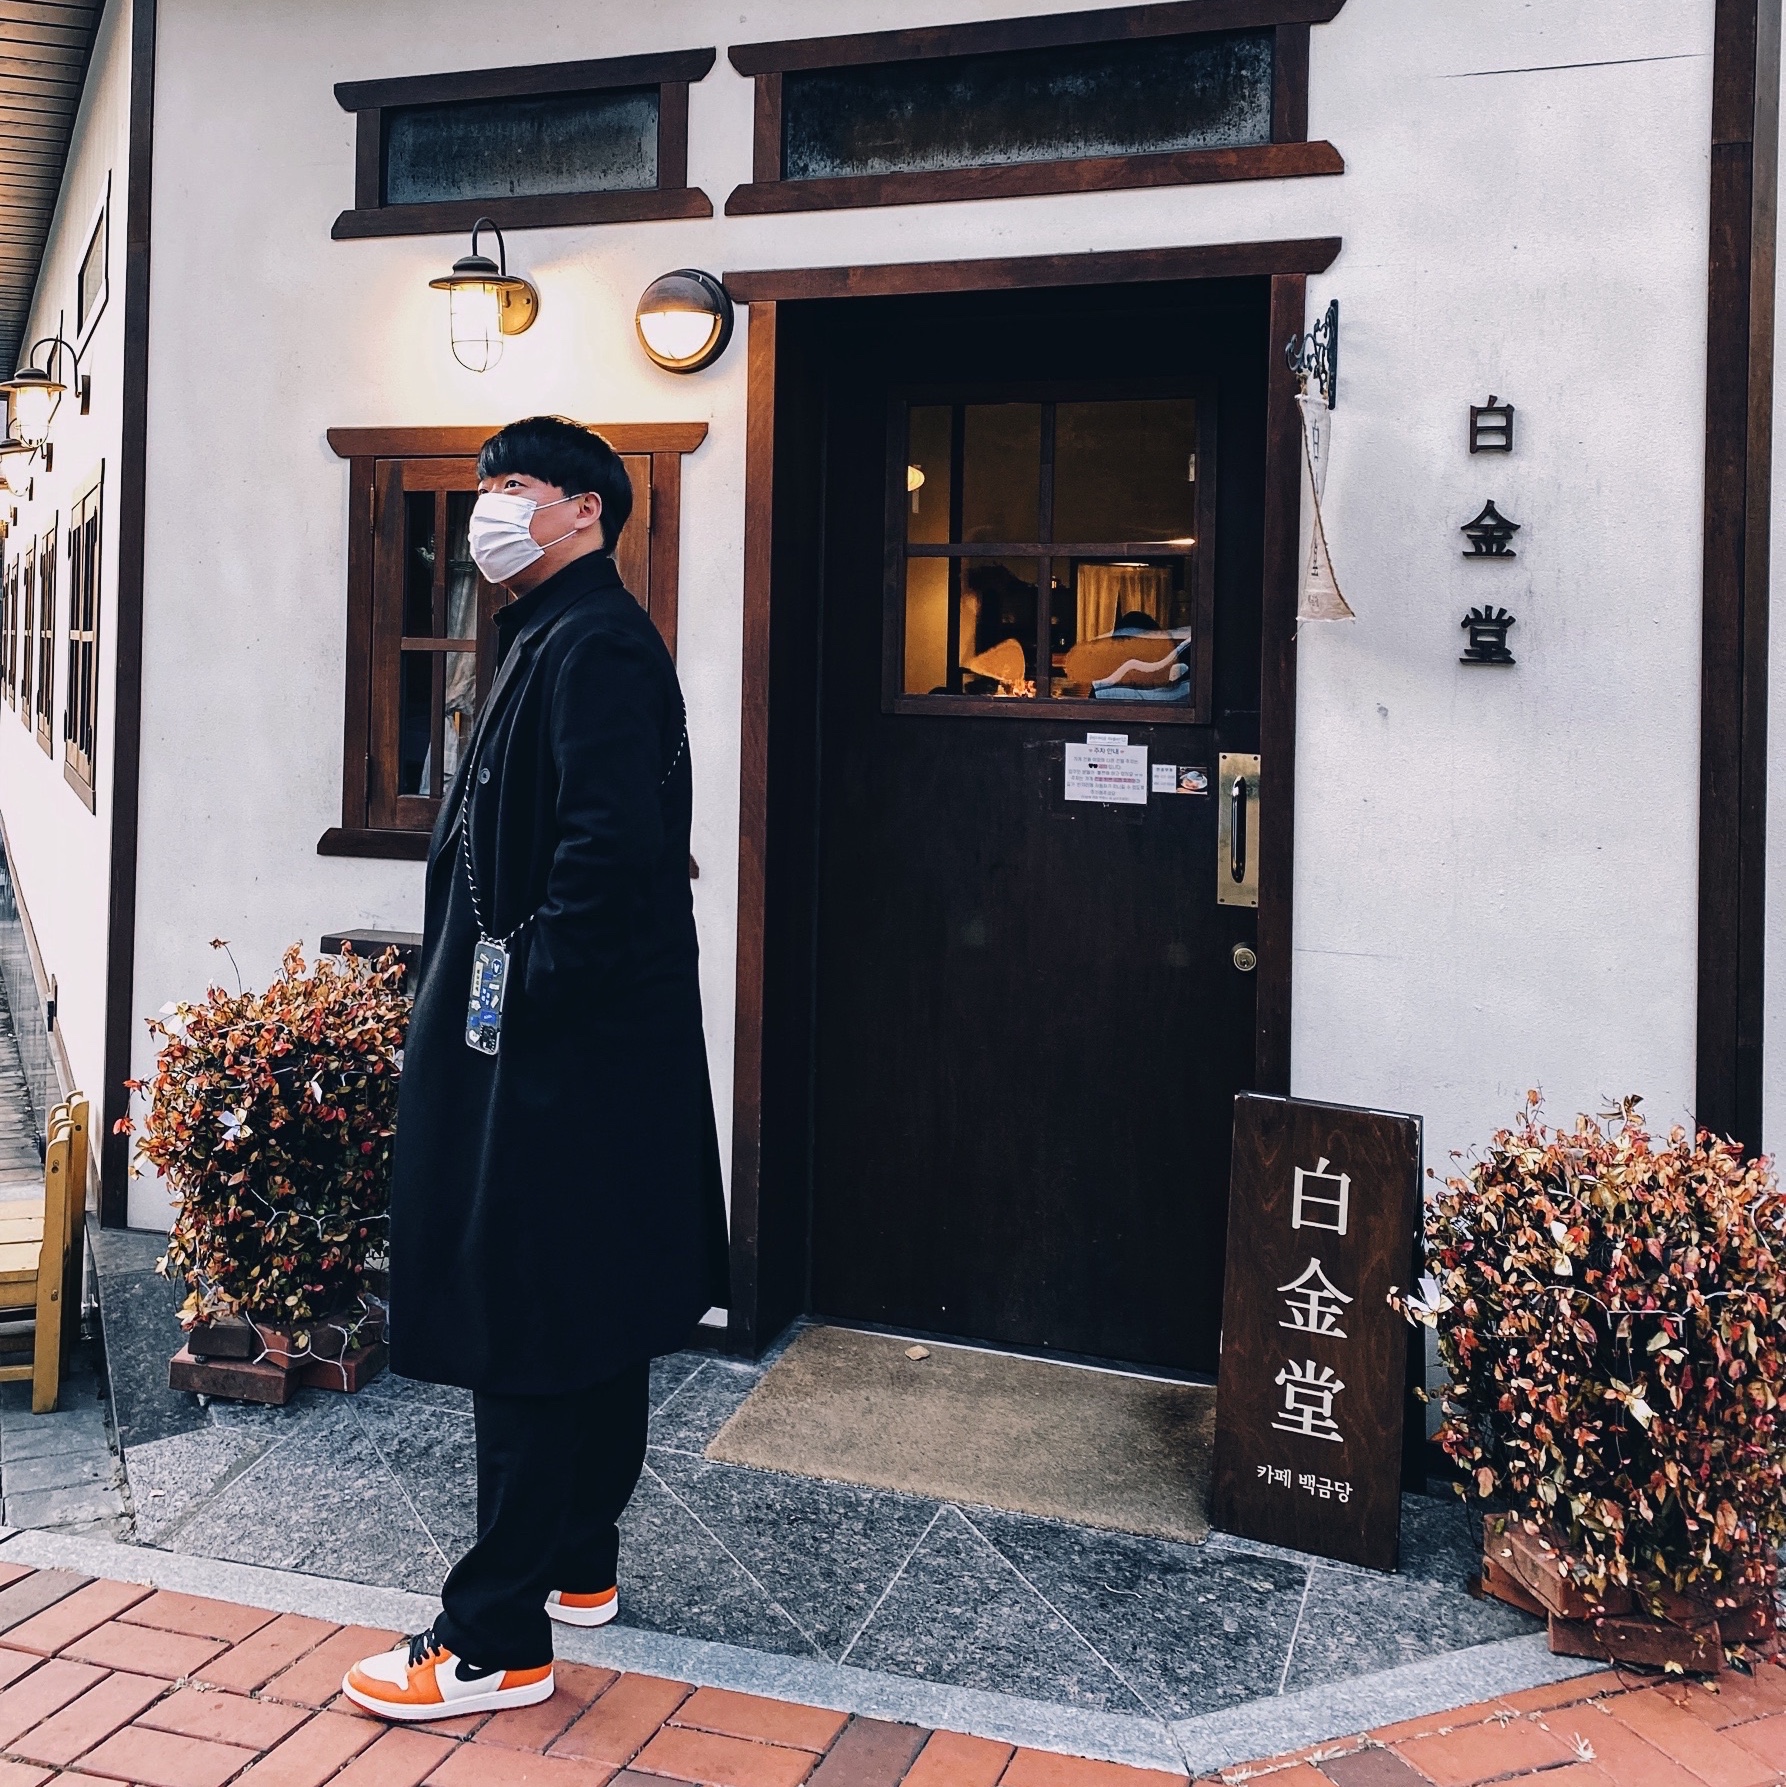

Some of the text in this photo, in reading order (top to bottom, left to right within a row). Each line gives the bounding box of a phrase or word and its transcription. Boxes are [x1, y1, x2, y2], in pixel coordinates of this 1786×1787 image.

[1459, 394, 1521, 665] 白金堂
[1271, 1156, 1354, 1443] 白金堂
[1257, 1464, 1353, 1503] 카페 백금당
